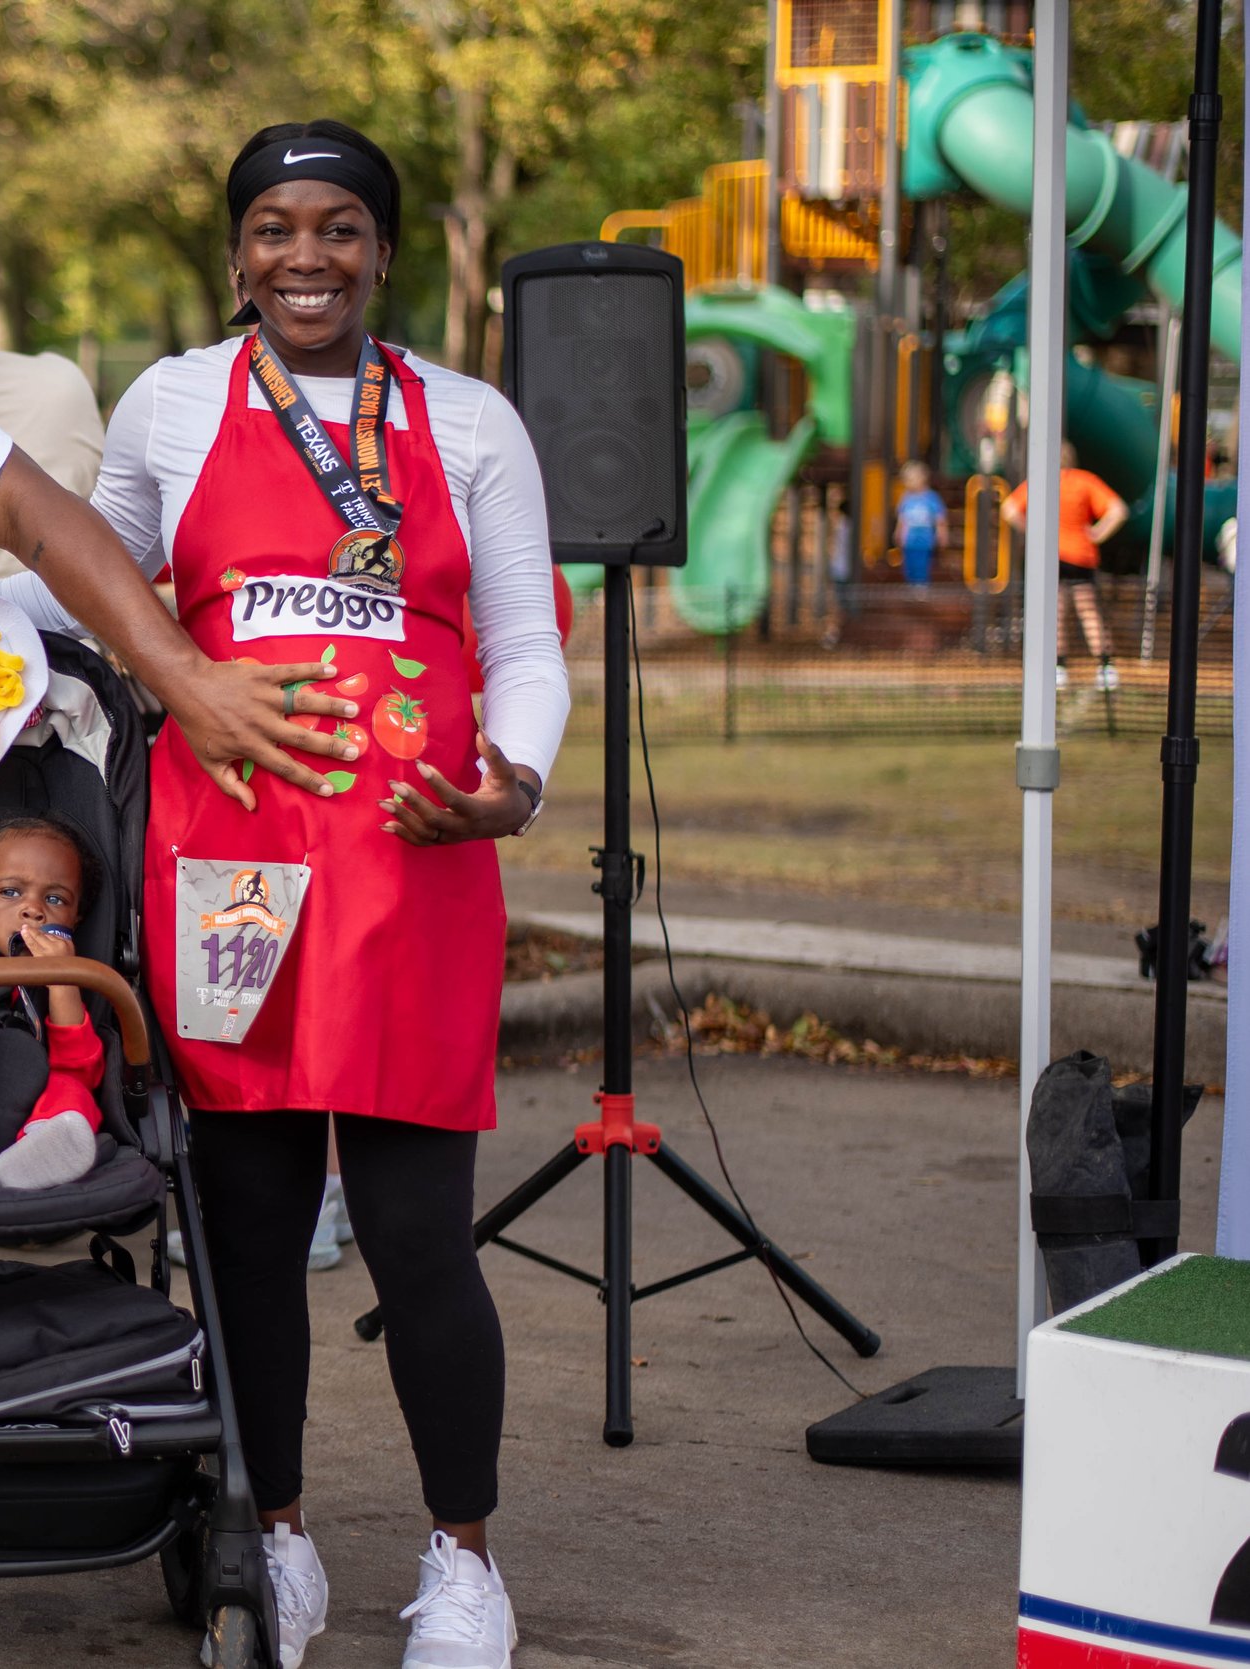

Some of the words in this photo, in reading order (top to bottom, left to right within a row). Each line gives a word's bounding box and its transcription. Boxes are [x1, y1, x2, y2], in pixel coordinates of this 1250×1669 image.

[256, 354, 297, 411] FINISHER
[364, 361, 385, 382] 5K
[359, 383, 382, 417] DASH
[295, 414, 339, 473] TEXANS
[339, 501, 366, 528] FALLS
[351, 496, 380, 530] TRINIT
[242, 581, 395, 630] Preggo
[201, 933, 278, 989] 1120
[213, 989, 236, 998] TRINITY
[213, 998, 230, 1007] FALLS
